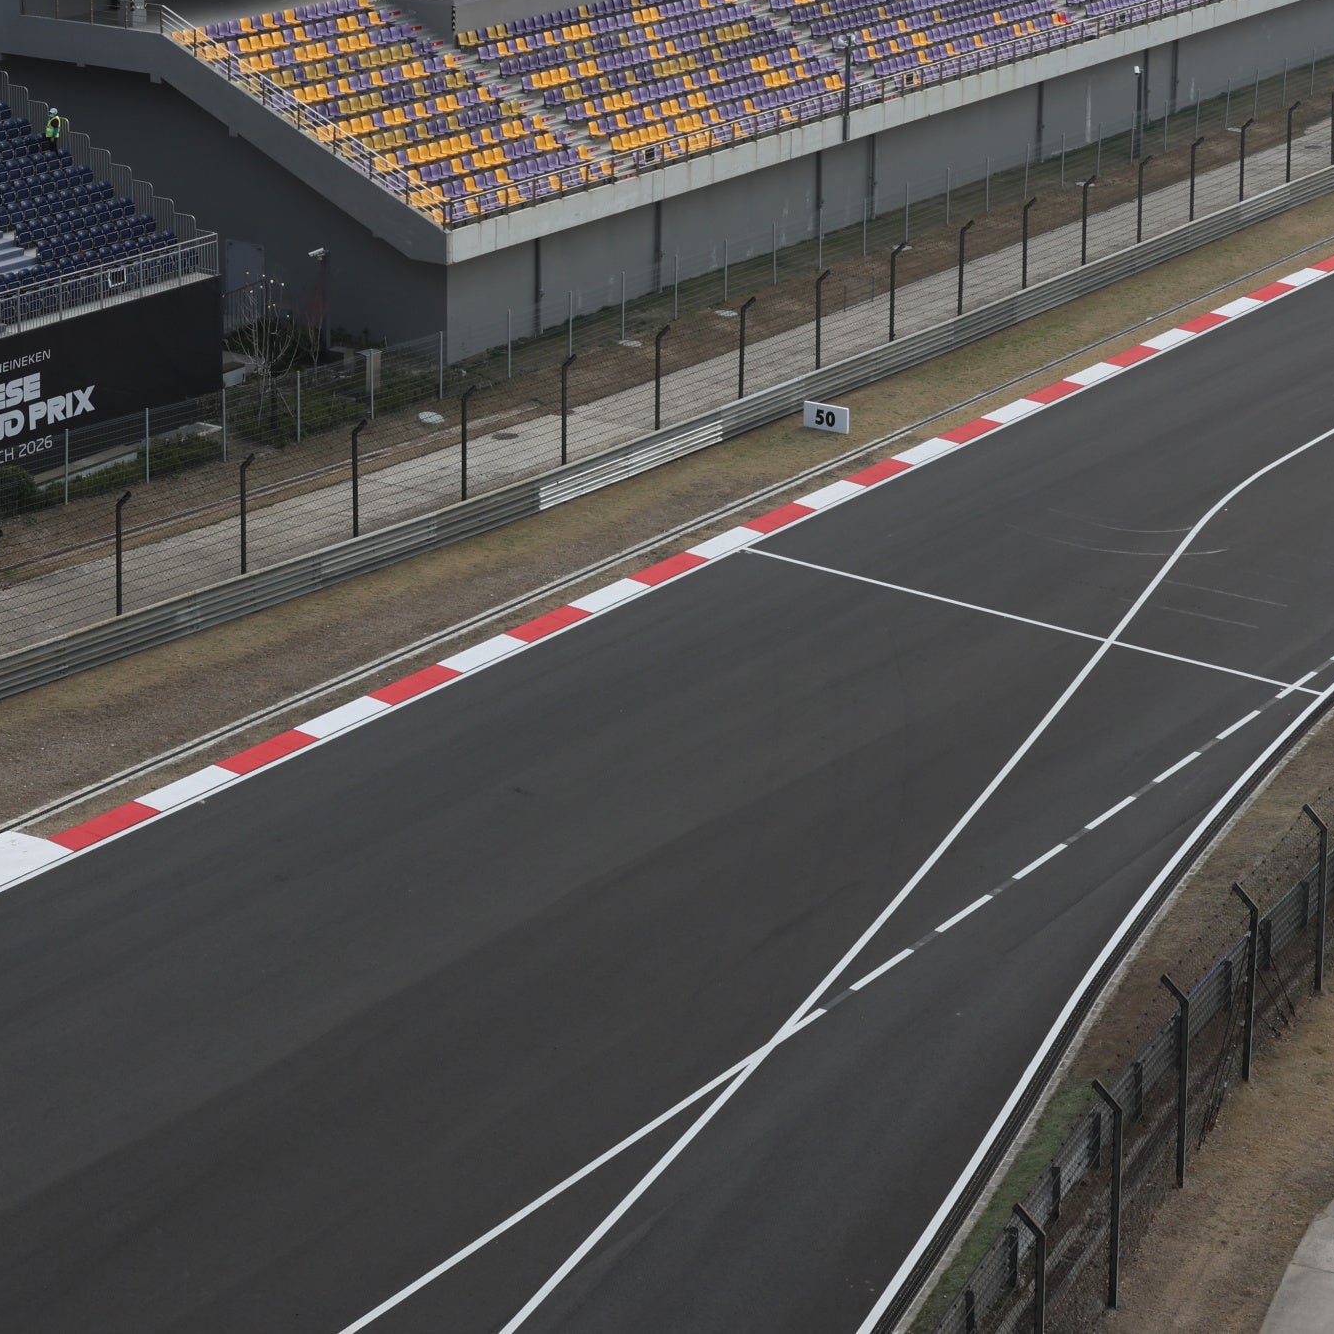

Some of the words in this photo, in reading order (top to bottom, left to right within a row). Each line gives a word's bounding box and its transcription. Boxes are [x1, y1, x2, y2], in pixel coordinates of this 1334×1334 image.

[28, 384, 96, 431] PRIX
[815, 409, 836, 427] 50
[18, 434, 53, 458] 2026
